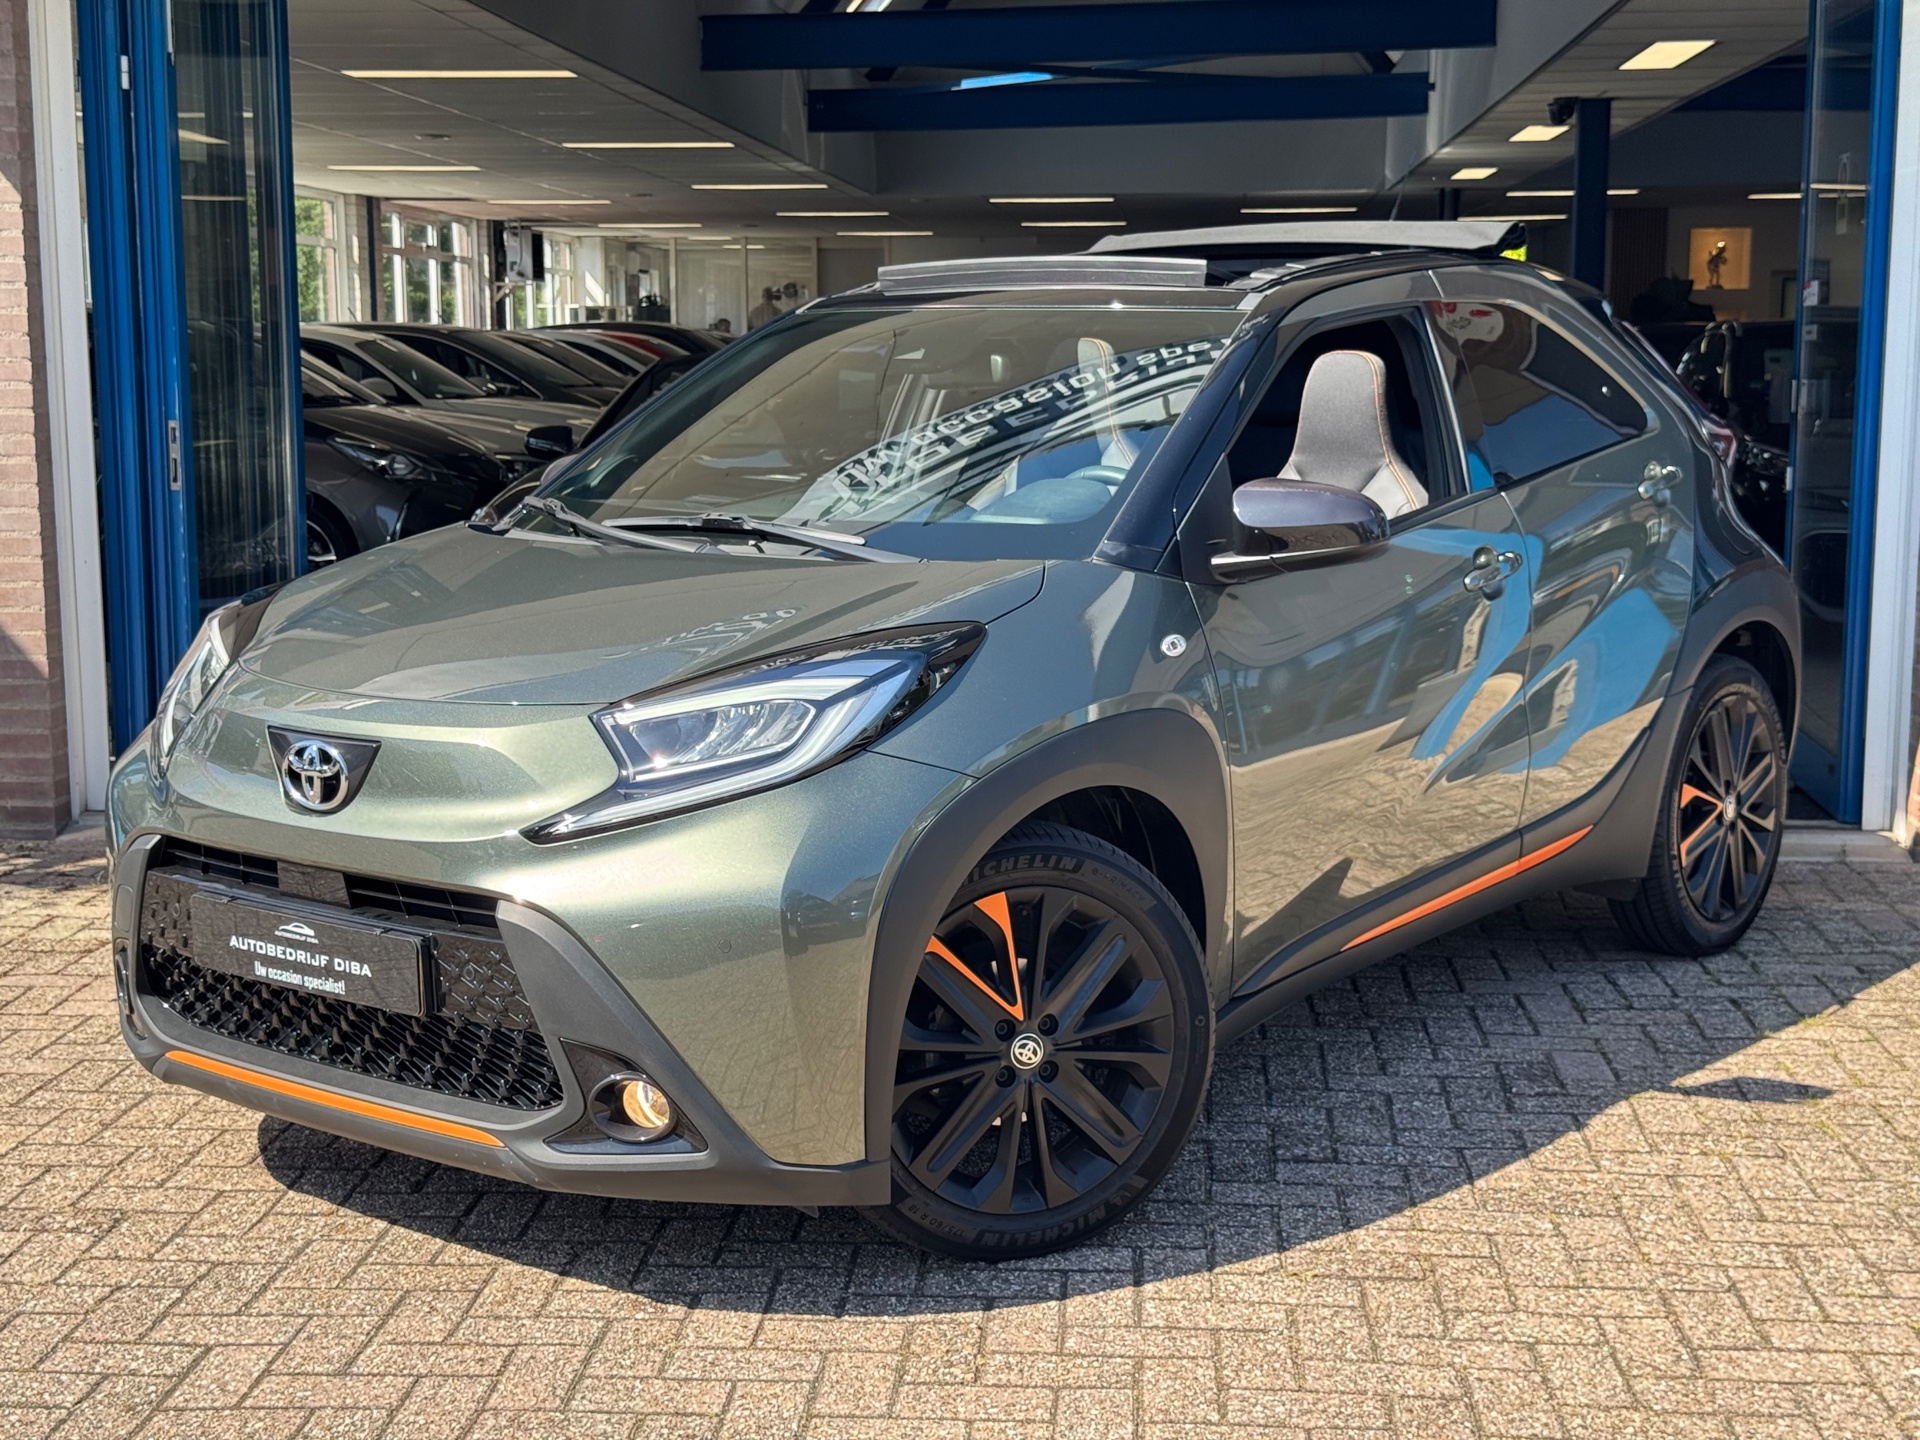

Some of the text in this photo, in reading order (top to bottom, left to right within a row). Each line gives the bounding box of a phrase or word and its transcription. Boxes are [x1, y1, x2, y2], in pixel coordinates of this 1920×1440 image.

[963, 854, 1078, 887] ICHELIN
[229, 935, 372, 977] AUTOBEDRIJF DIBA
[254, 961, 346, 995] Uw occasion specialist!
[907, 1203, 965, 1238] 175/60 R 18
[980, 1204, 1107, 1247] MICHELIN
